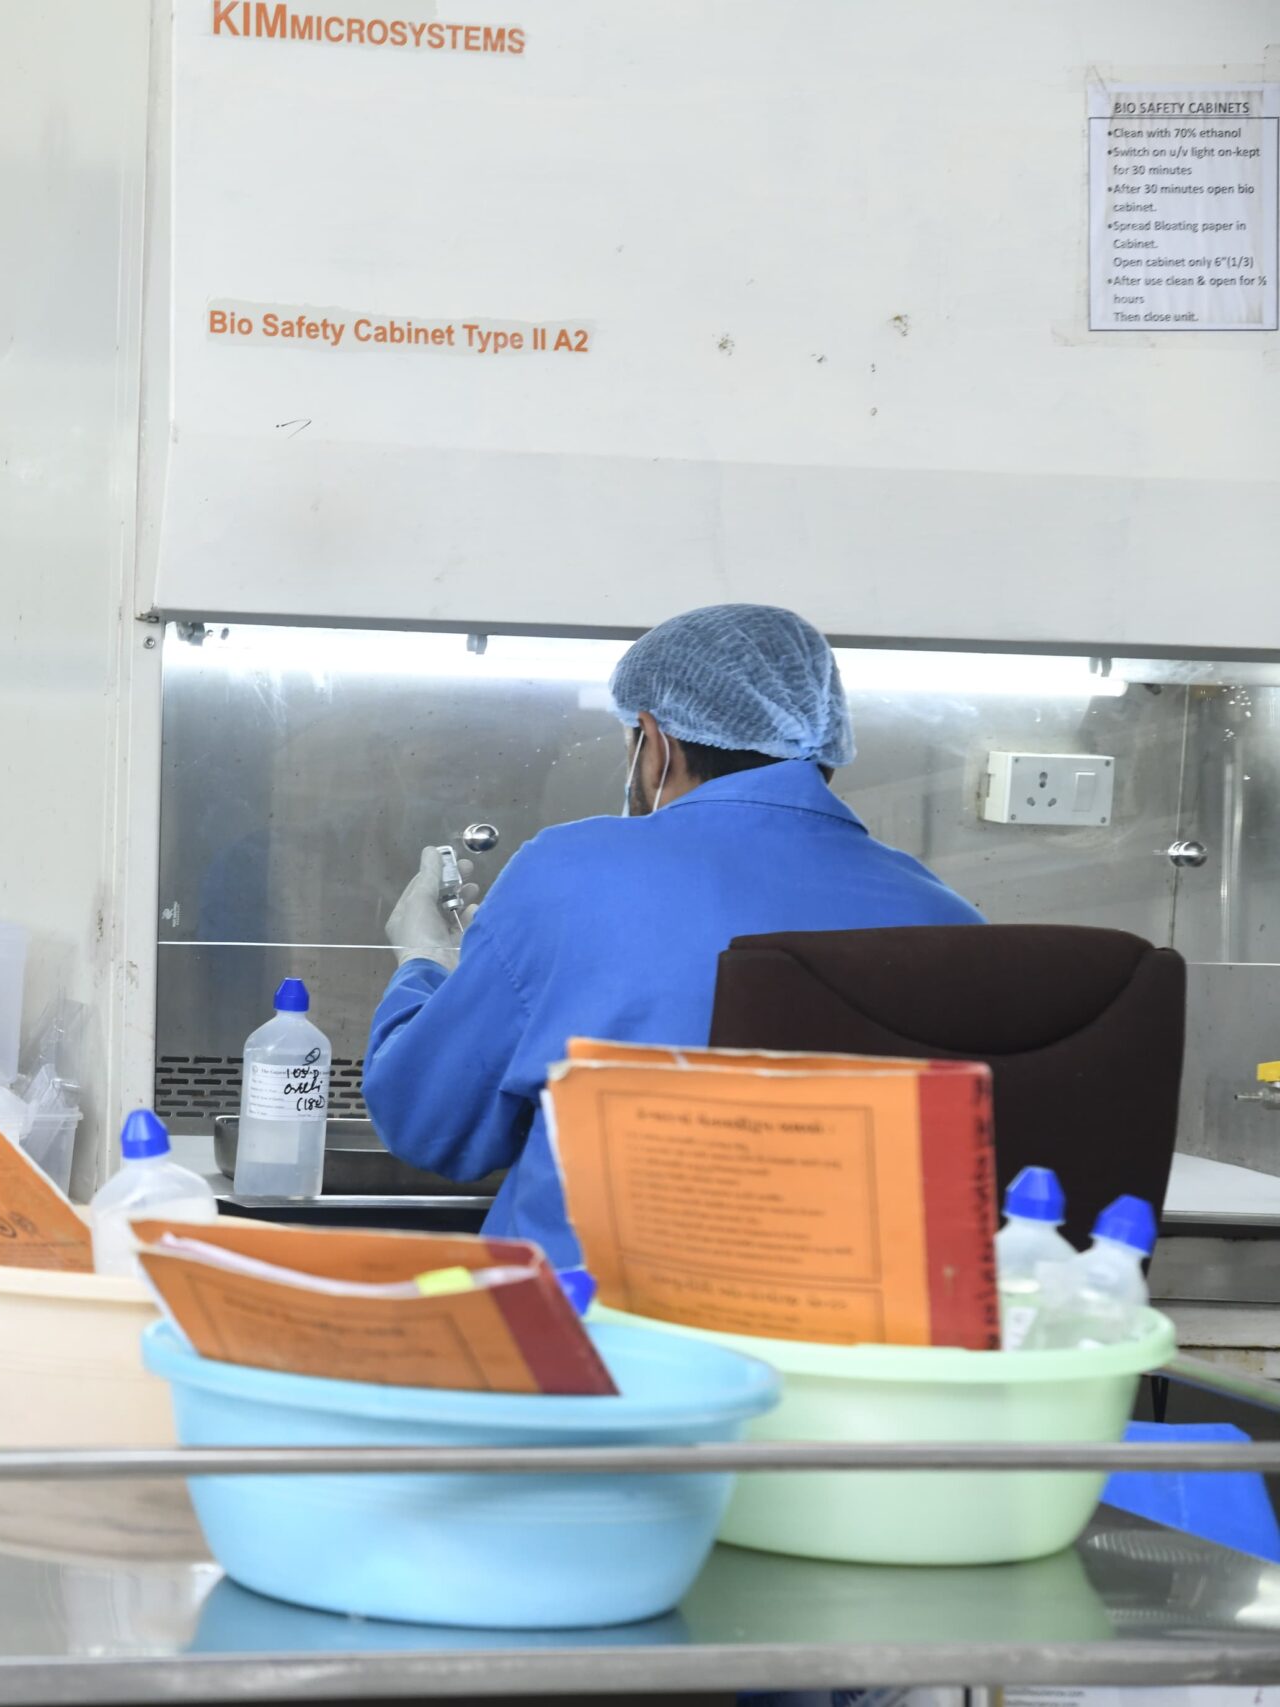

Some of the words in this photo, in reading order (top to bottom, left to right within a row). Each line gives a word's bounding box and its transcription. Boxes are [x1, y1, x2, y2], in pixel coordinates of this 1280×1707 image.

[1113, 102, 1136, 114] BIO
[1139, 102, 1185, 114] SAFETY
[1188, 102, 1250, 114] CABINETS
[1113, 128, 1143, 138] Clean
[1147, 128, 1171, 138] with
[1174, 128, 1197, 138] 70%
[1199, 128, 1241, 138] ethanol
[1113, 147, 1149, 157] Switch
[1152, 149, 1166, 157] on
[1170, 146, 1189, 158] u/v
[1190, 147, 1215, 160] light
[1217, 147, 1261, 160] on-kept
[1113, 165, 1129, 175] for
[1131, 165, 1146, 175] 30
[1148, 165, 1193, 175] minutes
[1113, 184, 1141, 194] After
[1144, 184, 1158, 194] 30
[1160, 184, 1204, 194] minutes
[1207, 186, 1234, 196] open
[1237, 184, 1255, 194] bio
[1113, 203, 1157, 213] cabinet.
[1113, 221, 1151, 232] Spread
[1201, 223, 1233, 233] paper
[1236, 221, 1247, 231] in
[1113, 239, 1158, 249] Cabinet.
[1113, 257, 1143, 269] Open
[1145, 257, 1185, 267] cabinet
[1188, 257, 1212, 269] only
[1113, 276, 1141, 286] After
[1144, 278, 1162, 286] use
[1164, 276, 1194, 286] clean
[1196, 276, 1206, 286] &
[1209, 278, 1237, 288] open
[1239, 276, 1255, 286] for
[1113, 294, 1145, 304] hours
[1113, 312, 1141, 322] Then
[1144, 312, 1171, 322] close
[1173, 312, 1199, 322] unit.
[209, 310, 253, 336] Bio
[262, 313, 345, 347] Safety
[353, 319, 455, 347] Cabinet
[462, 324, 524, 354] Type
[532, 328, 546, 351] II
[553, 329, 590, 353] A2
